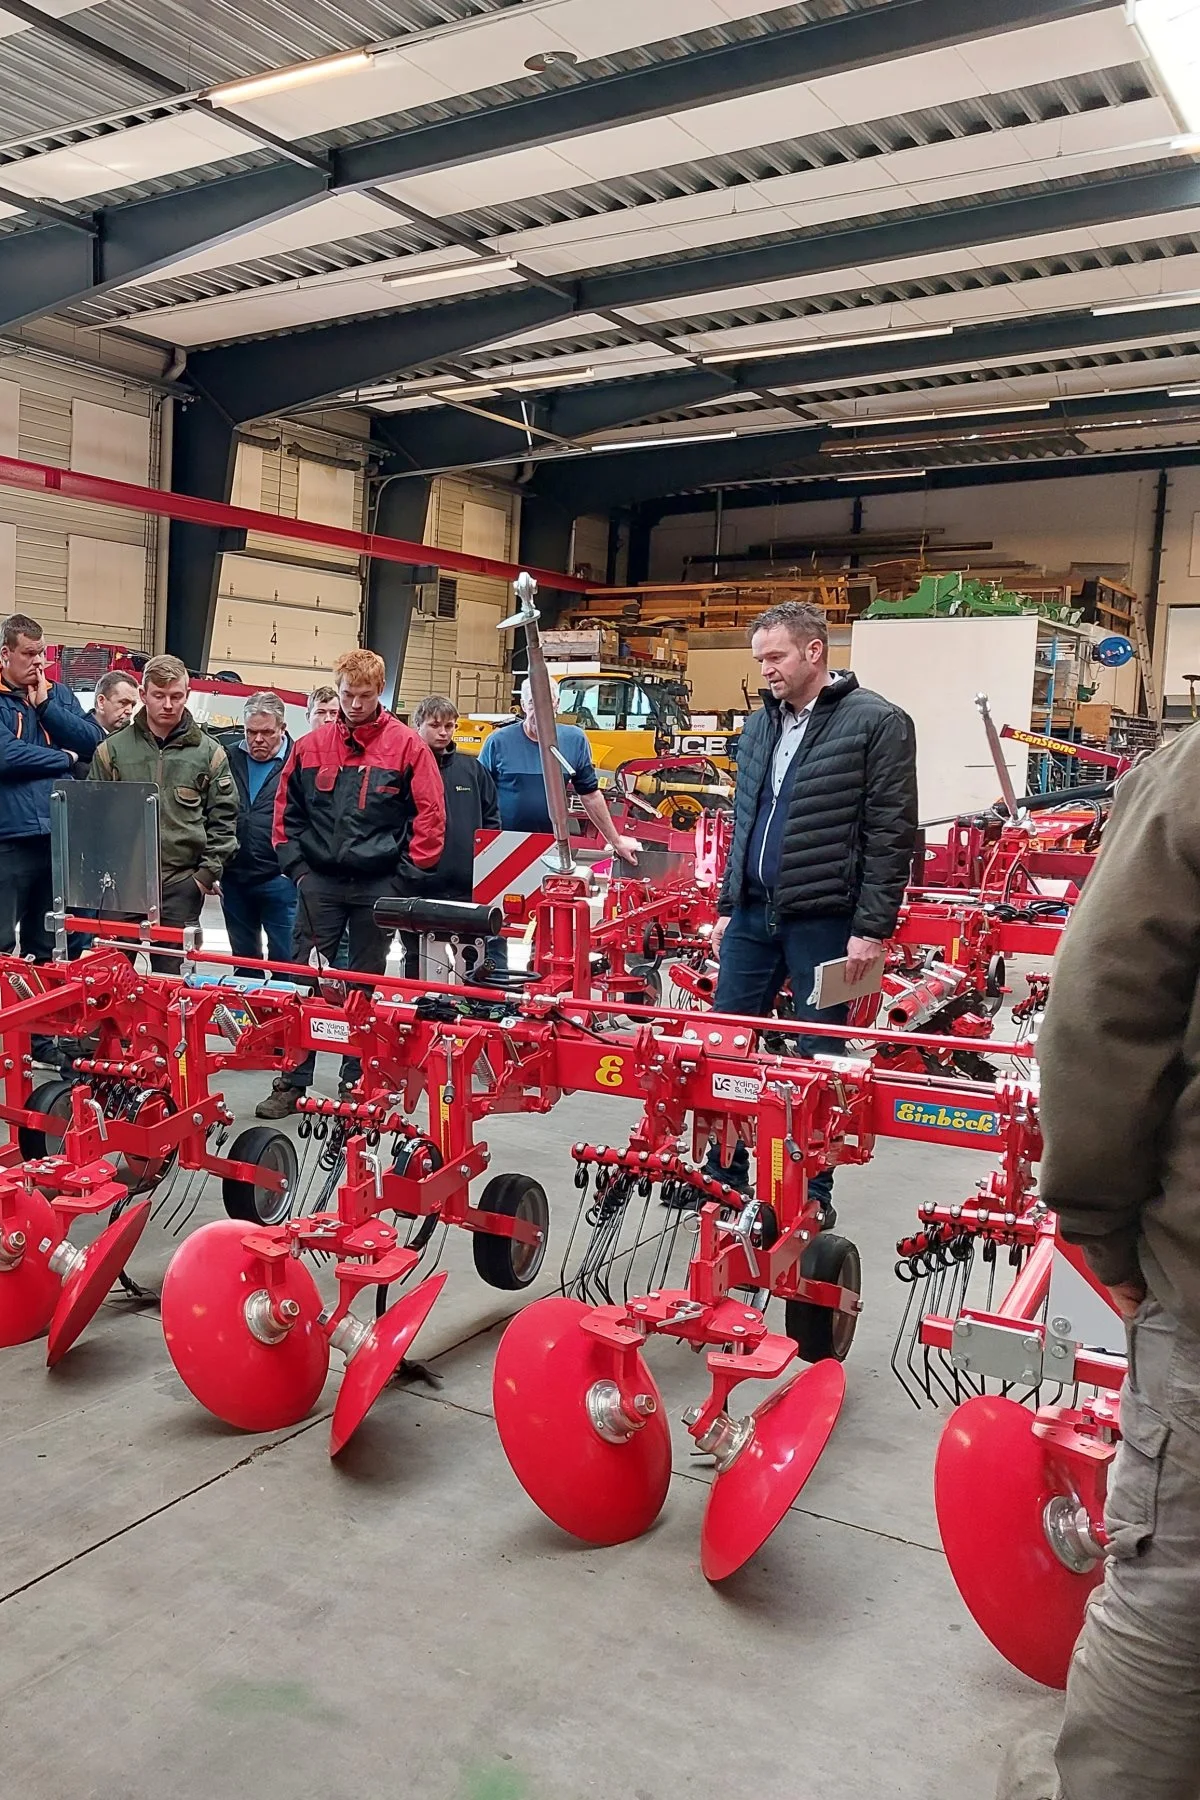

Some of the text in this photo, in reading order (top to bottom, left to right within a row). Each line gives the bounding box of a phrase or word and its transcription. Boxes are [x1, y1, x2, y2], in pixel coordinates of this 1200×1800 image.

[270, 632, 277, 645] 4
[669, 736, 728, 755] JCB
[1012, 730, 1077, 754] ScanStone
[734, 1079, 760, 1090] Yding
[897, 1104, 993, 1132] Einböck
